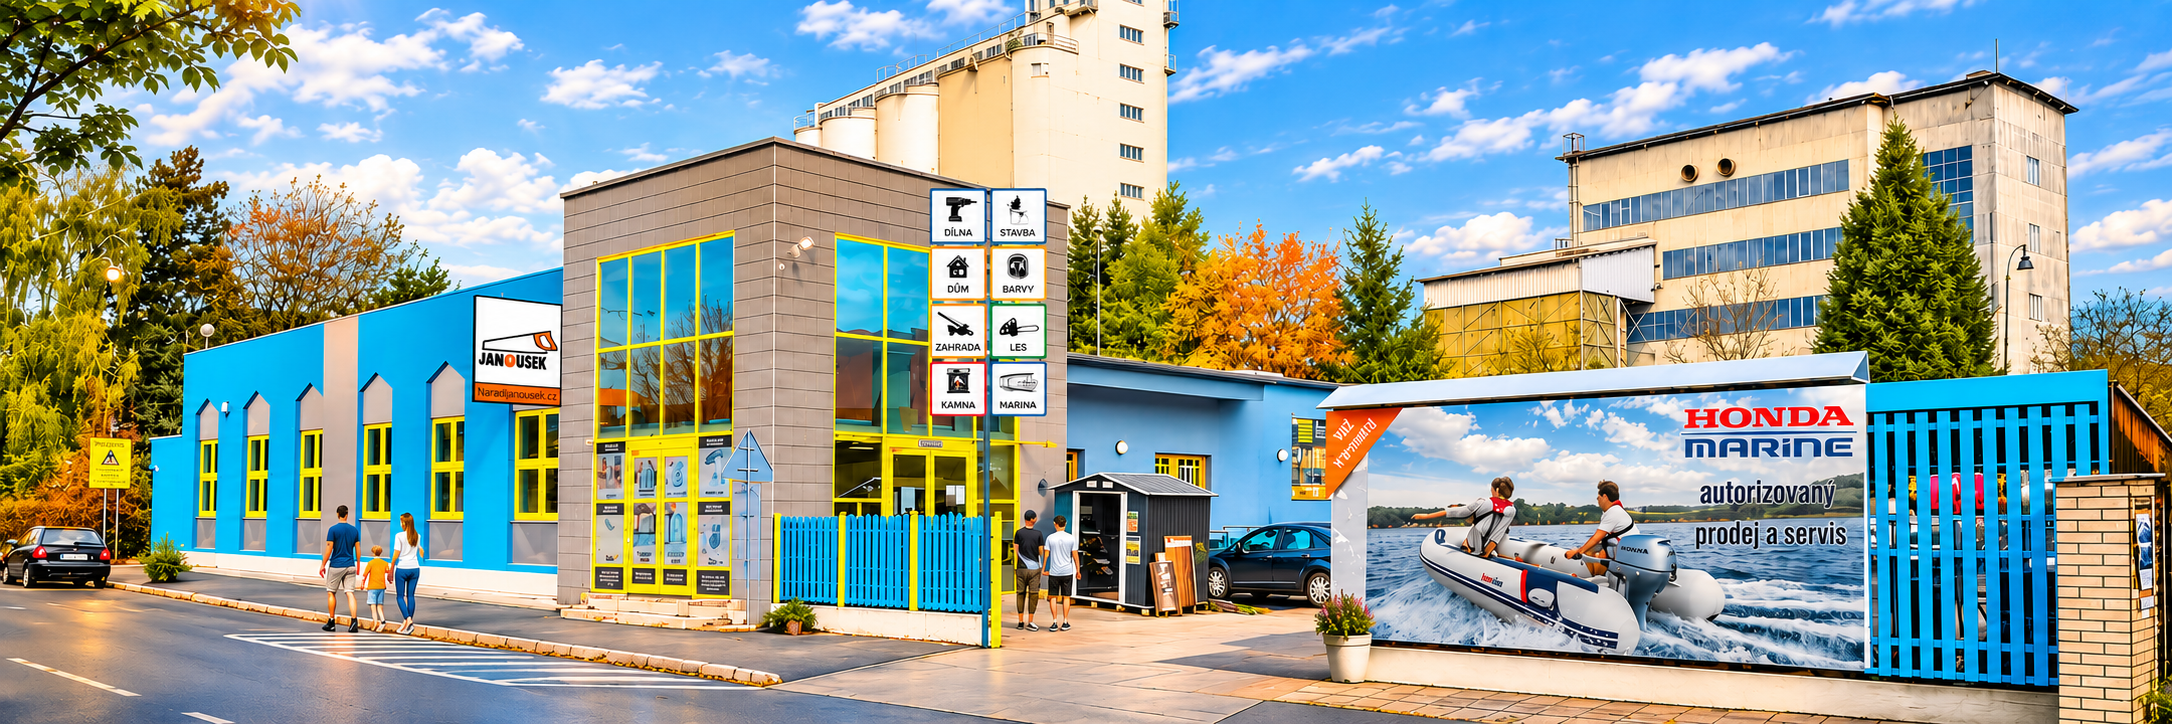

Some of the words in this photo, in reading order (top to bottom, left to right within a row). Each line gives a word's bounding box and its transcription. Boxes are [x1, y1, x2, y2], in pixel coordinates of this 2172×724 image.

[944, 227, 973, 237] DÍLNA
[999, 228, 1036, 237] STAVBA
[947, 282, 969, 293] DŮM
[1002, 285, 1034, 293] BARVY
[935, 343, 981, 351] ZAHRADA
[1010, 343, 1027, 352] LES
[478, 352, 547, 370] JANOUSEK
[941, 401, 976, 409] KAMNA
[999, 401, 1037, 409] MARINA
[1684, 406, 1854, 429] HONDA
[1684, 437, 1854, 458] MARINE
[1700, 480, 1836, 508] autorizovaný
[1695, 521, 1759, 549] prodej
[1766, 526, 1778, 545] a
[1784, 522, 1847, 545] servis
